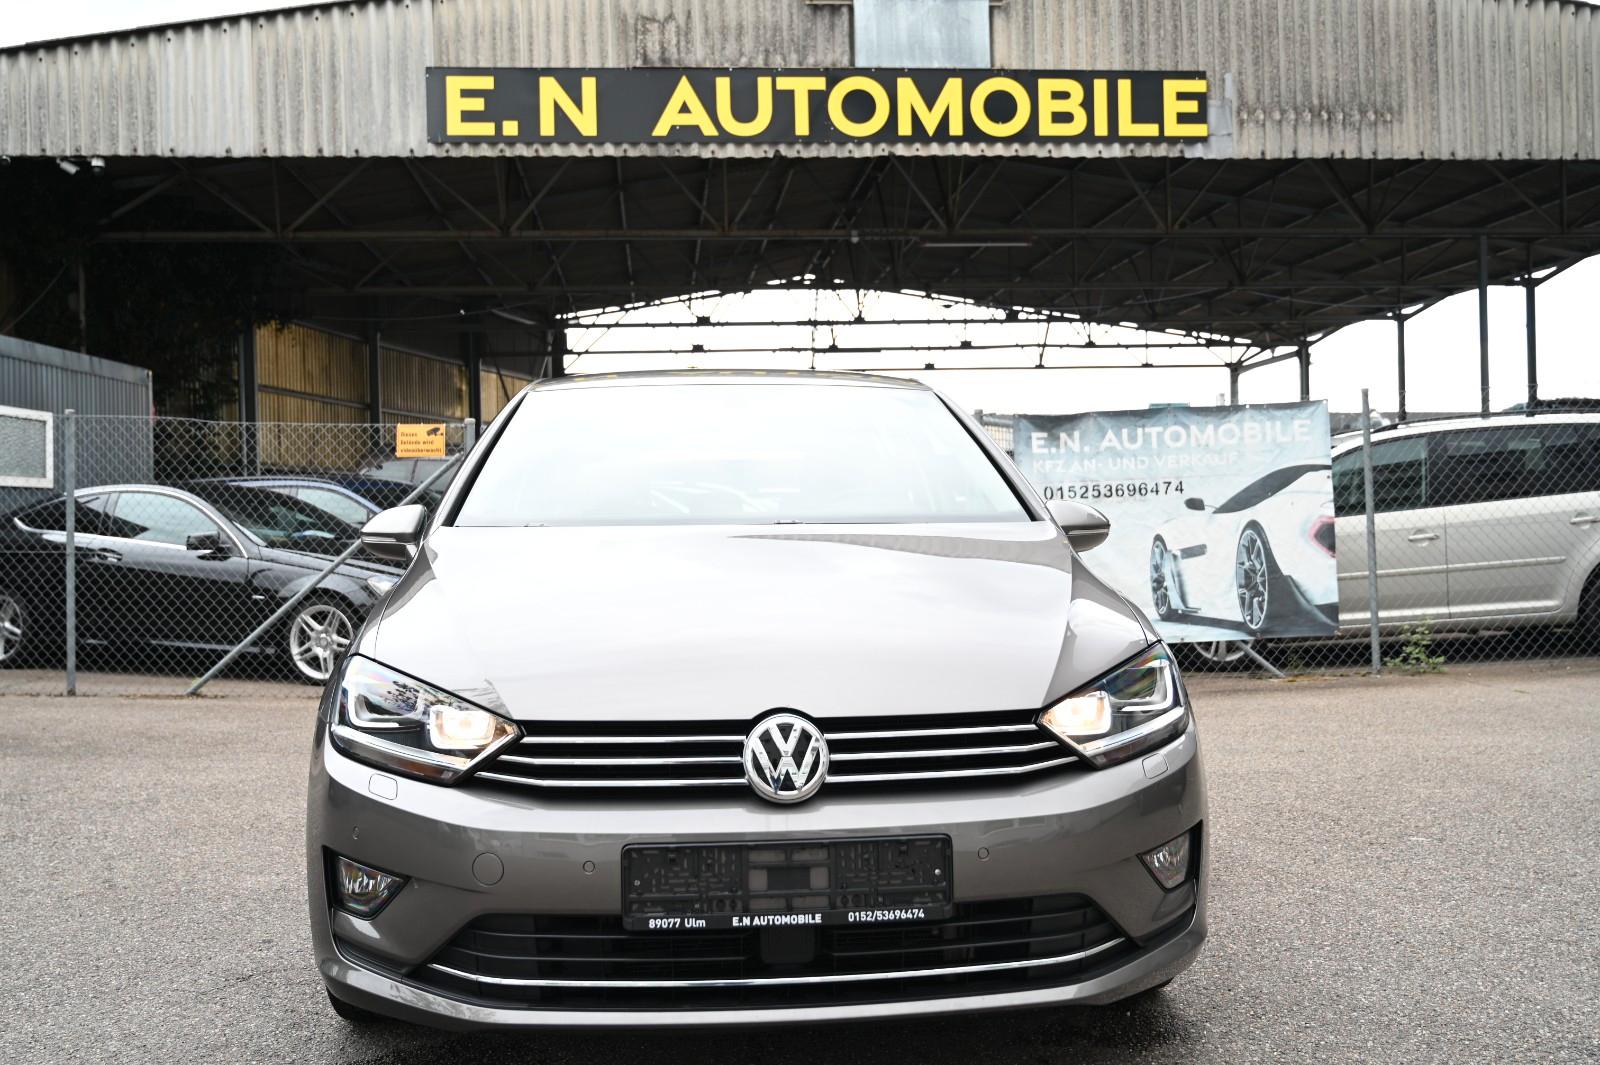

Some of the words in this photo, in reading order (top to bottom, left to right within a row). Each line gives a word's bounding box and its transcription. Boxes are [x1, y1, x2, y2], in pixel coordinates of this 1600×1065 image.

[445, 75, 597, 138] E.N
[651, 76, 1208, 138] AUTOMOBILE
[1030, 431, 1091, 455] E.N.
[1099, 418, 1312, 451] AUTOMOBILE
[1109, 454, 1149, 472] UND
[1154, 451, 1239, 469] VERKAUF
[1043, 480, 1185, 501] 015253696474
[648, 918, 681, 929] 89077
[684, 918, 706, 928] Ulm
[732, 914, 751, 926] E.N
[753, 913, 822, 926] AUTOMOBILE
[847, 908, 925, 922] 0152/53696474
